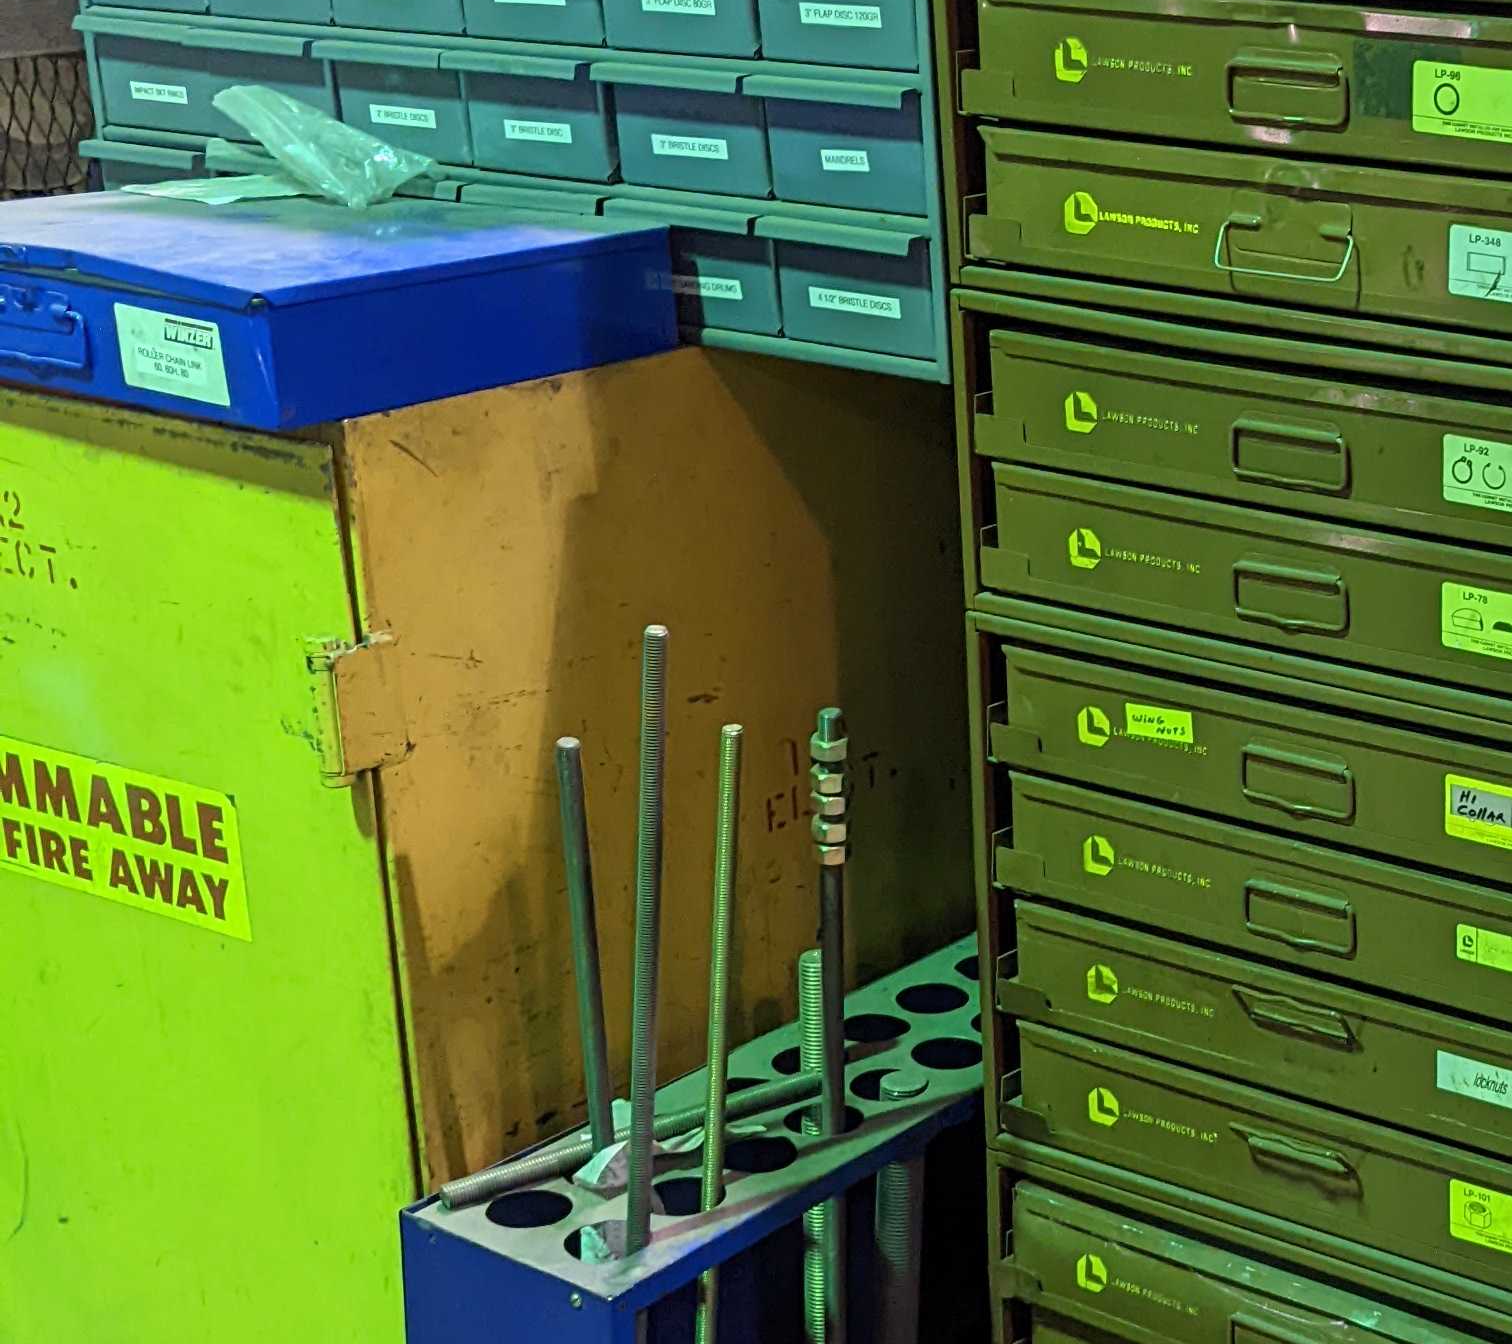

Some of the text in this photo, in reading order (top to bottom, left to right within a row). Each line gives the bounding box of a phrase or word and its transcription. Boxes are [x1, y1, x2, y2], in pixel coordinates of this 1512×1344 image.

[1184, 223, 1199, 234] INC
[1469, 234, 1502, 248] LP-348
[1464, 443, 1489, 457] LP-92
[2, 817, 229, 921] FIRE AWAY
[1474, 1072, 1509, 1095] locknuts
